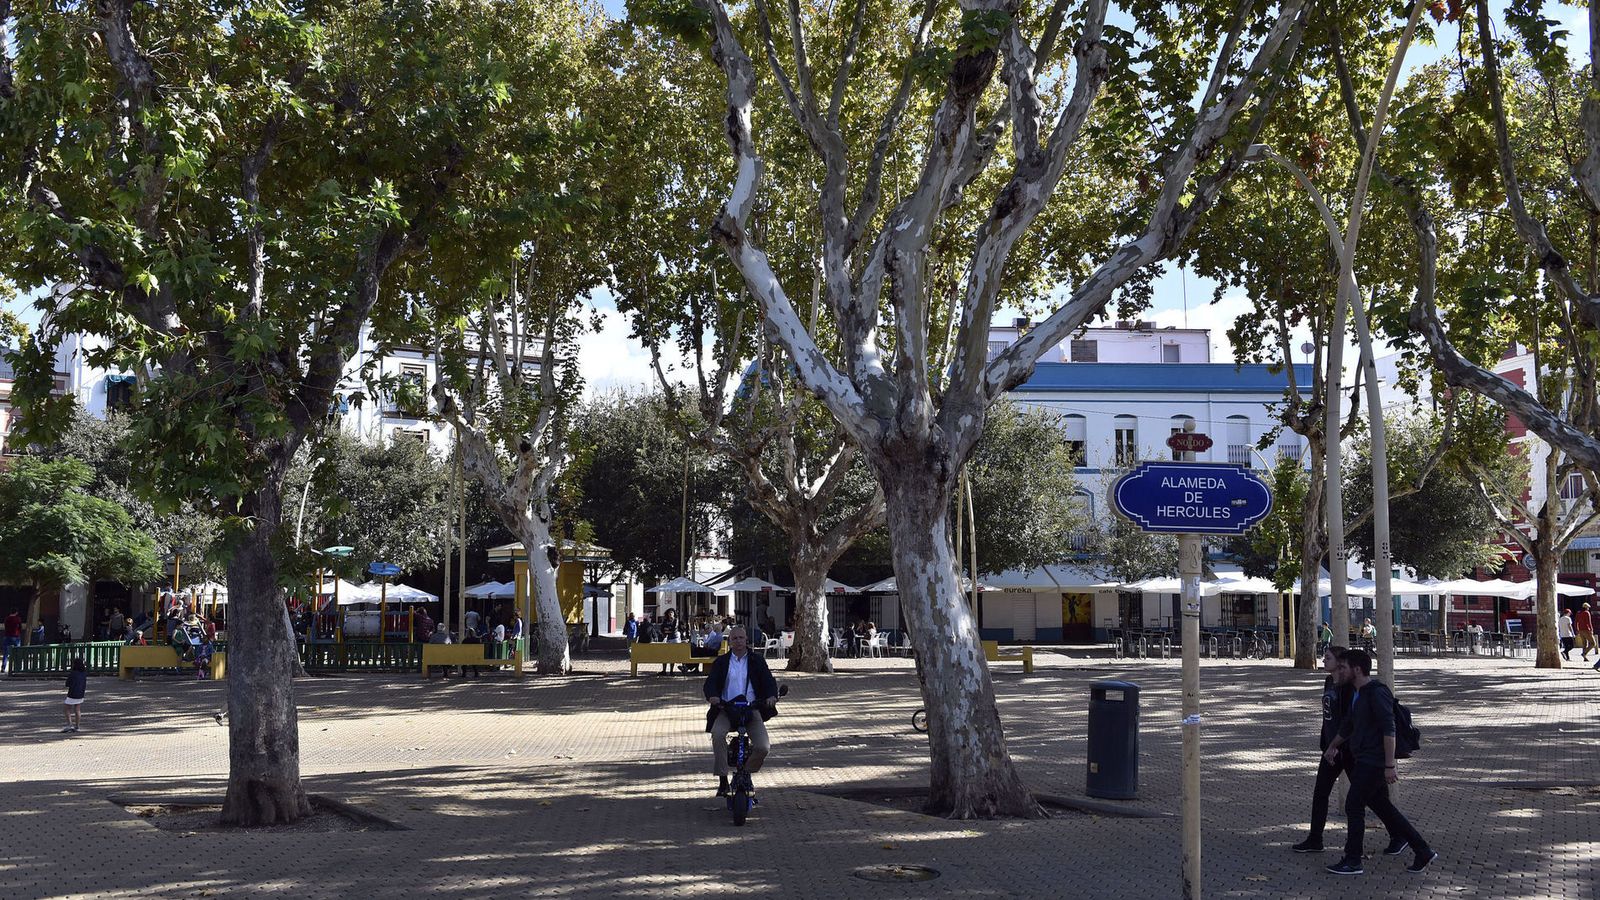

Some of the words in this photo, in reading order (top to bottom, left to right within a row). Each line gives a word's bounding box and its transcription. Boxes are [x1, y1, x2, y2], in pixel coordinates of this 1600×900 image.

[1161, 477, 1227, 489] ALAMEDA
[1184, 492, 1203, 504] DE
[1157, 506, 1231, 518] HERCULES
